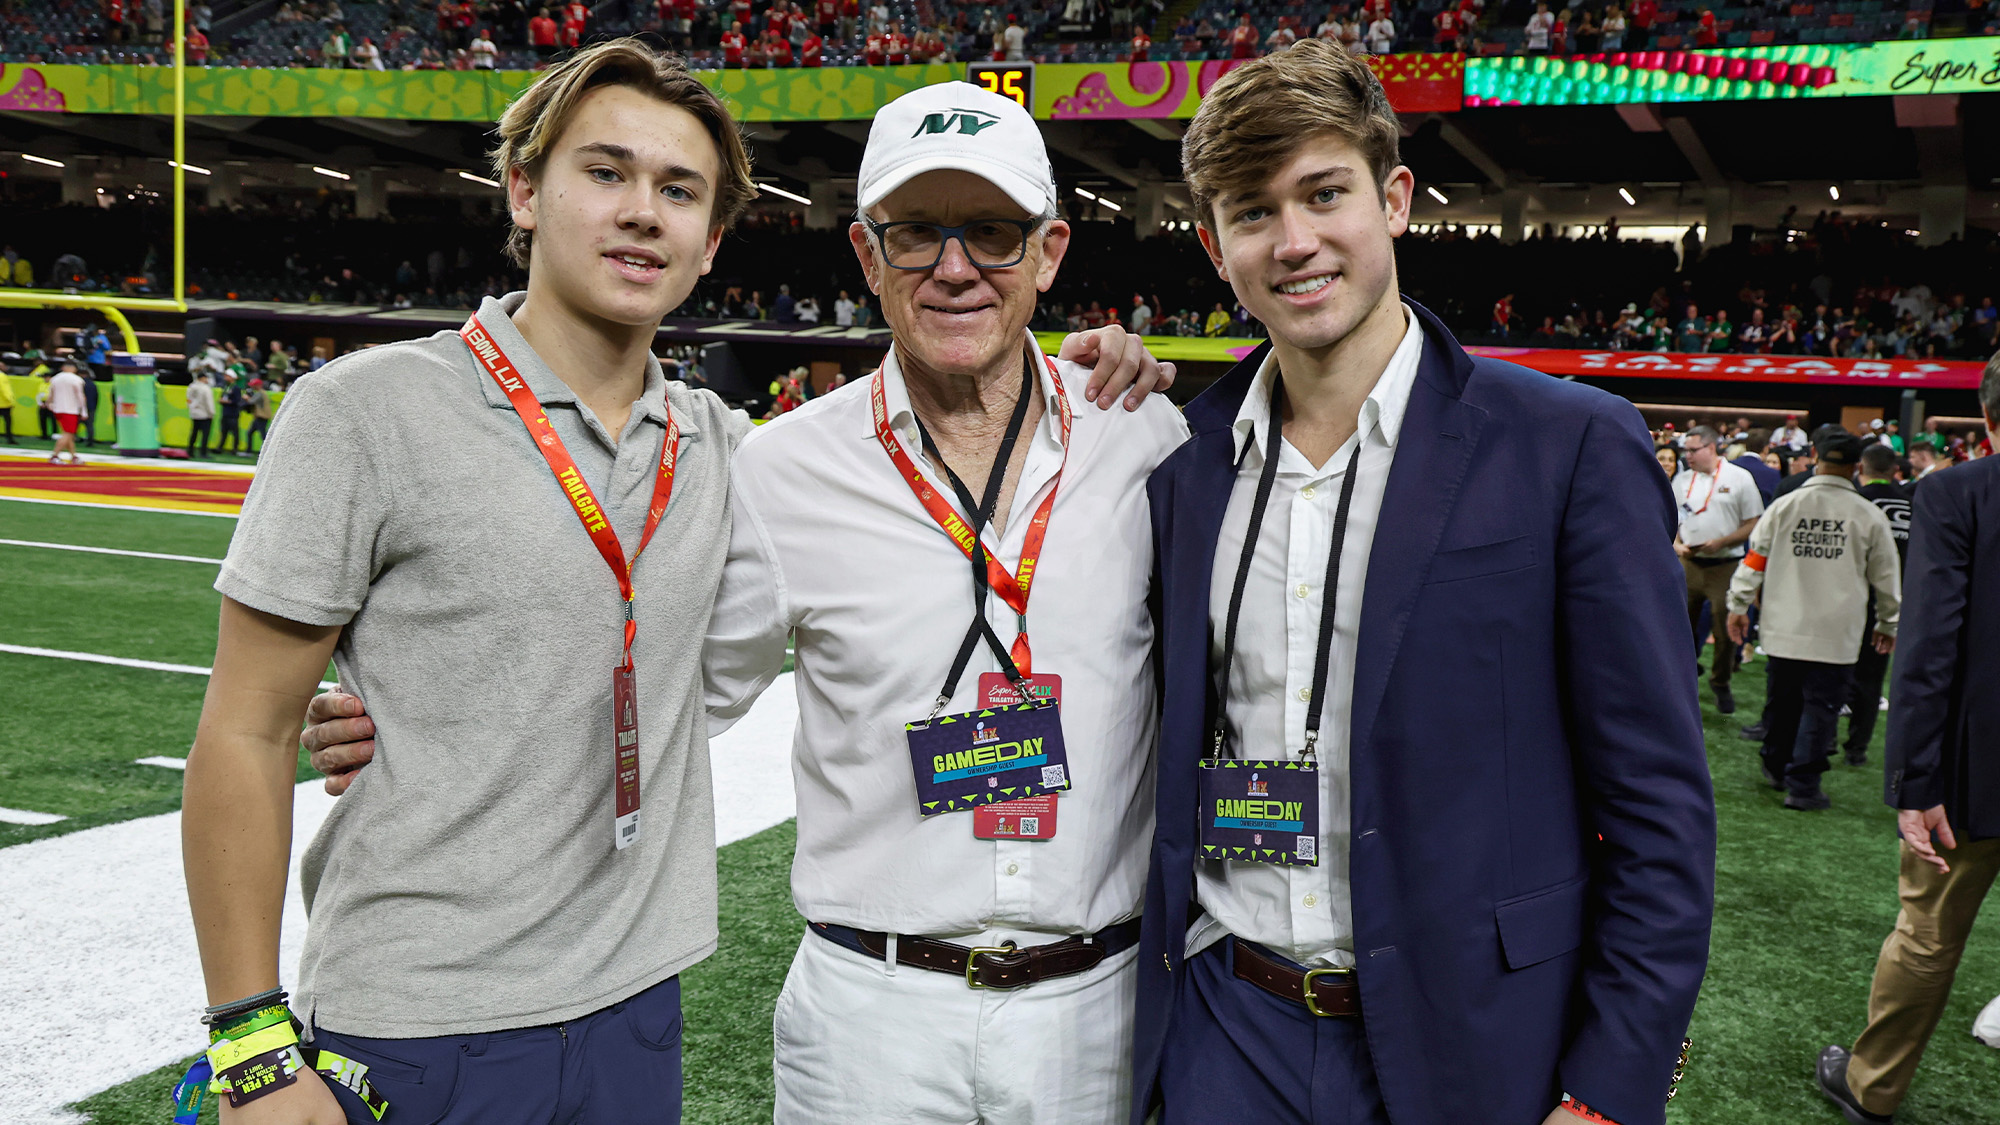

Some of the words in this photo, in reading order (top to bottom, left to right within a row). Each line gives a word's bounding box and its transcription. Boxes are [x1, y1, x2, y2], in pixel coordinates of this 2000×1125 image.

[1890, 51, 1977, 94] Super
[911, 107, 1001, 139] NY
[467, 328, 501, 370] BOWL
[494, 366, 524, 393] LIX
[873, 392, 886, 434] BOWL
[881, 429, 900, 457] LIX
[559, 466, 607, 534] TAILGATE
[1796, 518, 1846, 533] APEX
[1791, 531, 1848, 547] SECURITY
[1793, 544, 1844, 560] GROUP
[988, 684, 1012, 700] Super
[1035, 685, 1052, 696] LIX
[933, 737, 1044, 773] GAMEDAY
[967, 764, 998, 775] OWNERSHIP
[999, 761, 1016, 770] GUEST
[1216, 798, 1303, 821] GAMEDAY
[1240, 820, 1263, 828] OWNERSHIP
[248, 1063, 264, 1074] SHIFT
[256, 1064, 278, 1077] SECTION
[241, 1078, 262, 1094] PEN
[262, 1072, 276, 1085] SE
